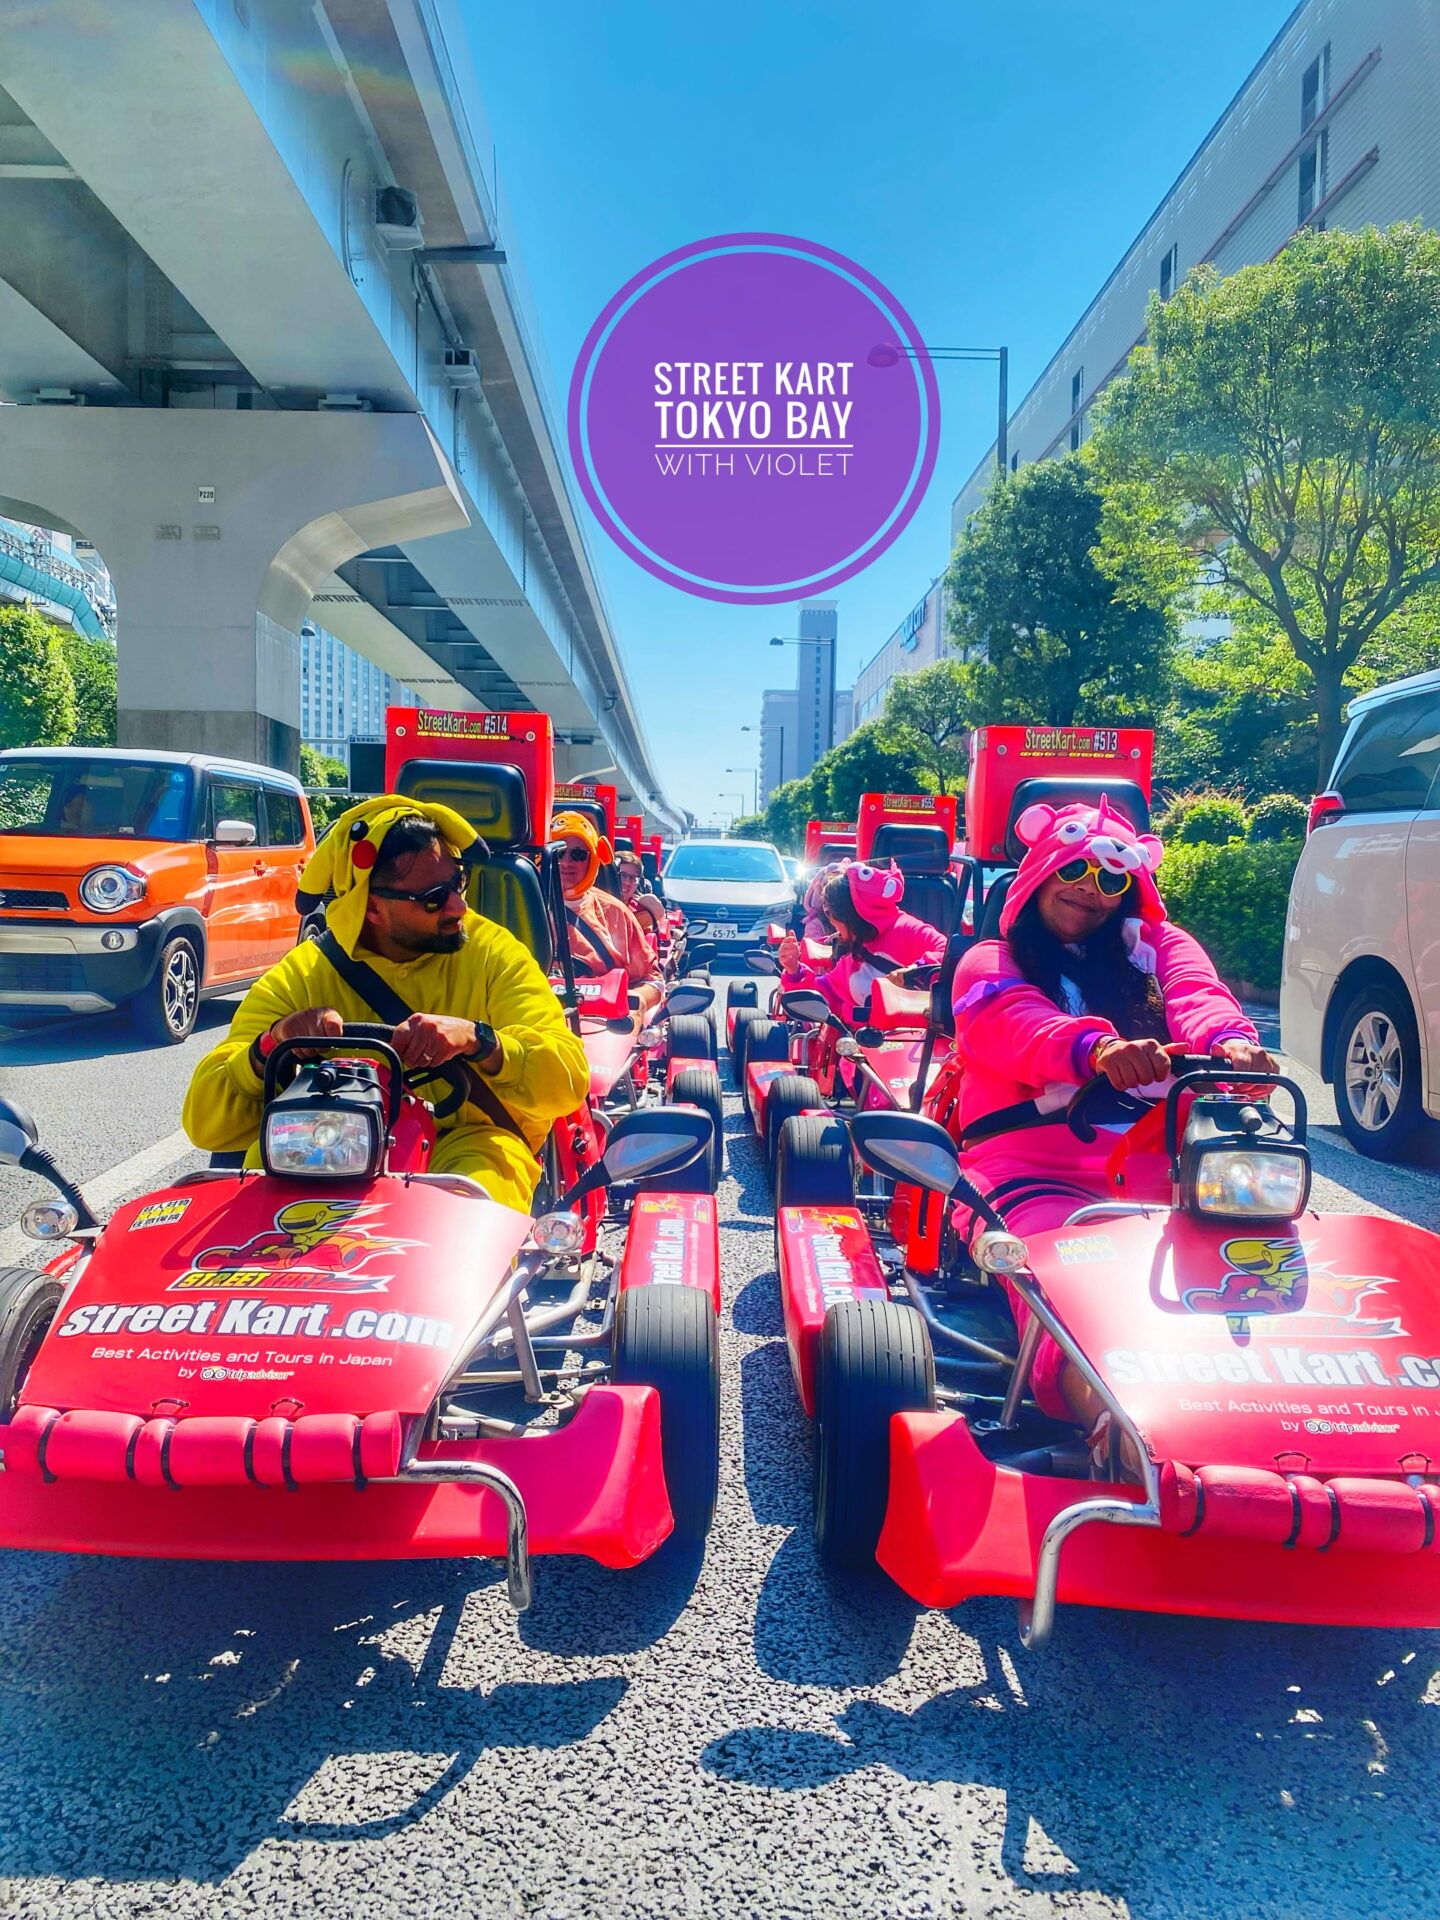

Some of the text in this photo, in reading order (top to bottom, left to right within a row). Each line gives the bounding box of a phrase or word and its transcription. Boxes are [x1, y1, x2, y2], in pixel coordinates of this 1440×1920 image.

[199, 490, 214, 499] P220
[417, 710, 508, 734] StreetKart.com #514
[1024, 728, 1118, 751] StreetKart.com #513
[712, 929, 736, 939] 65-75
[91, 1347, 393, 1367] Best Activities and Tours in Japan
[177, 1367, 197, 1379] by
[1398, 1355, 1440, 1389] .c
[1179, 1399, 1221, 1412] Best
[1228, 1399, 1313, 1415] Activities
[1317, 1402, 1350, 1415] and
[1353, 1402, 1408, 1416] Tours
[1410, 1403, 1430, 1416] in
[1280, 1419, 1300, 1432] by
